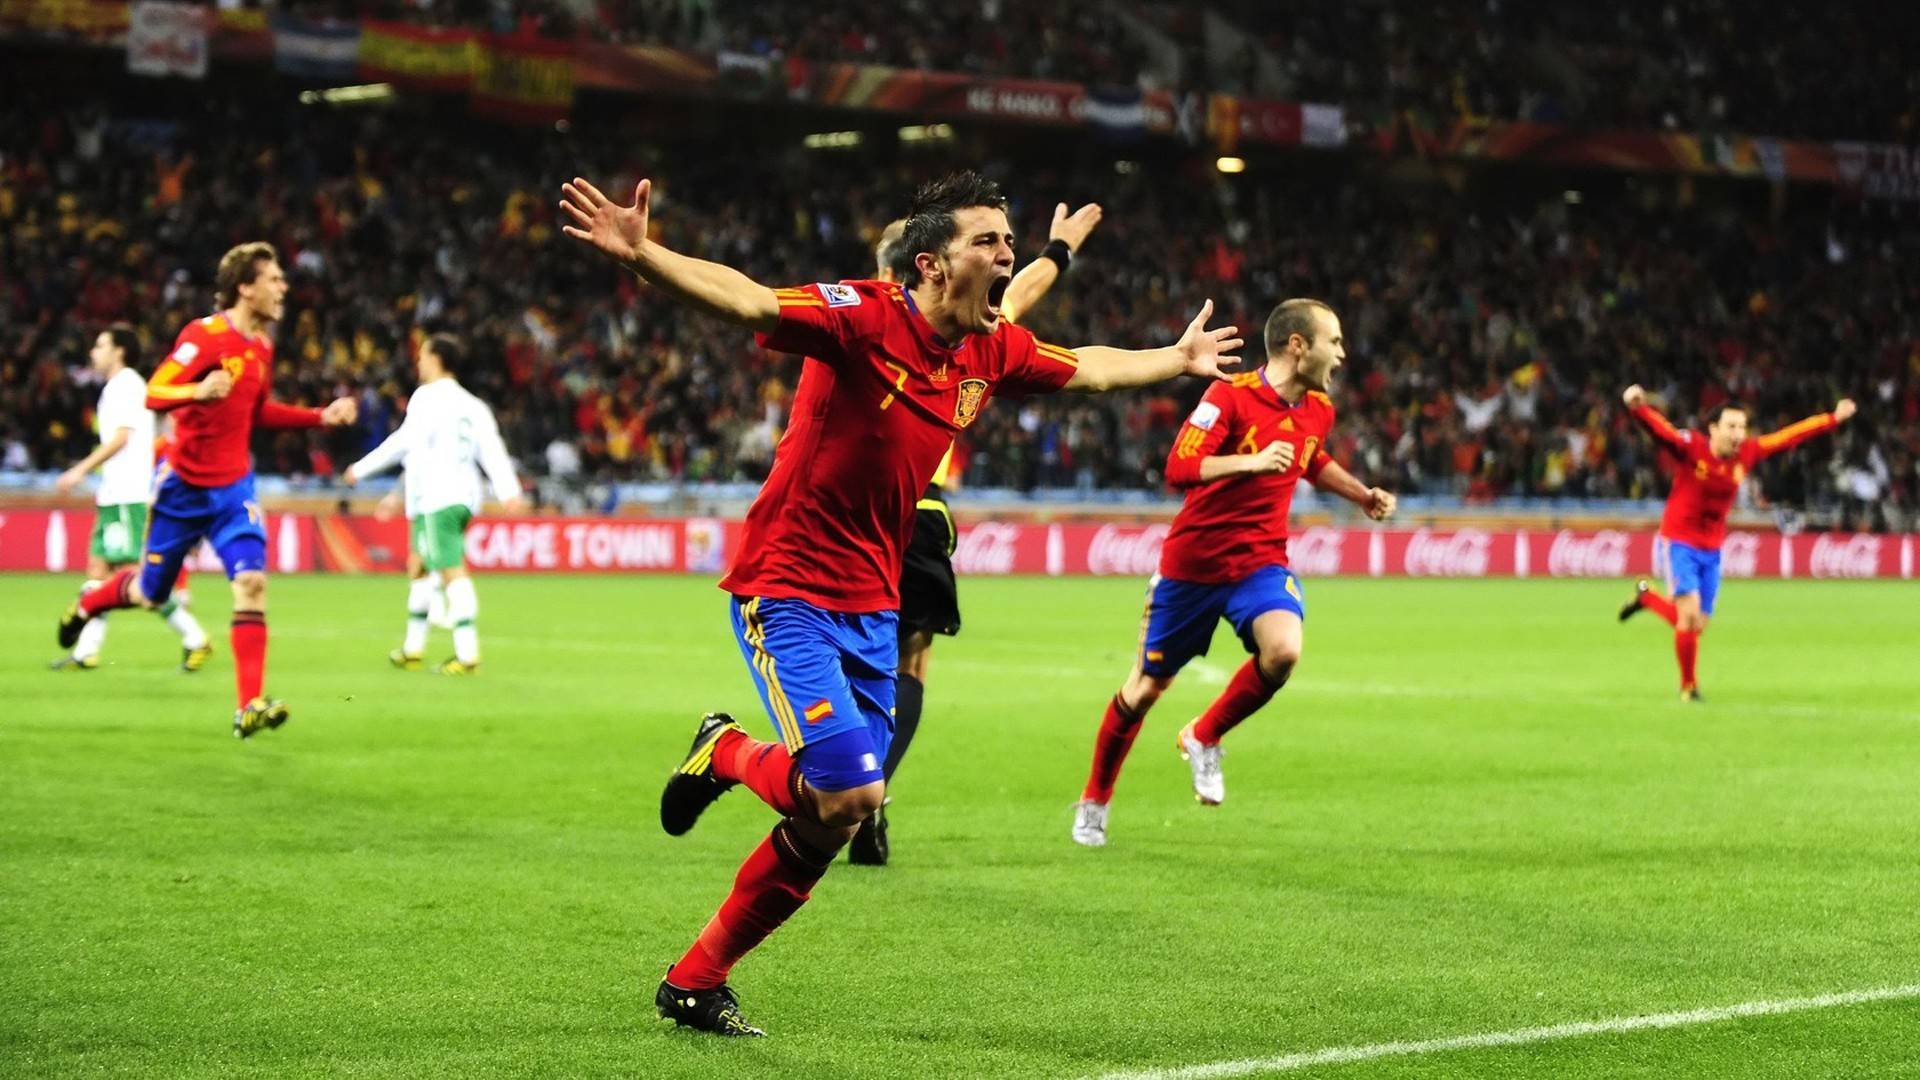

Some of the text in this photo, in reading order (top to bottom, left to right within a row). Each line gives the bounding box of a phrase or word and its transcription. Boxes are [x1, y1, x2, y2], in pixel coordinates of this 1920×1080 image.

[880, 361, 908, 410] 7
[1237, 425, 1258, 455] 6
[464, 522, 675, 568] CAPE TOWN
[1404, 526, 1493, 576] Coca-Cola
[1548, 528, 1632, 576] Coca-Cola
[1810, 532, 1881, 577] Coca-Cola
